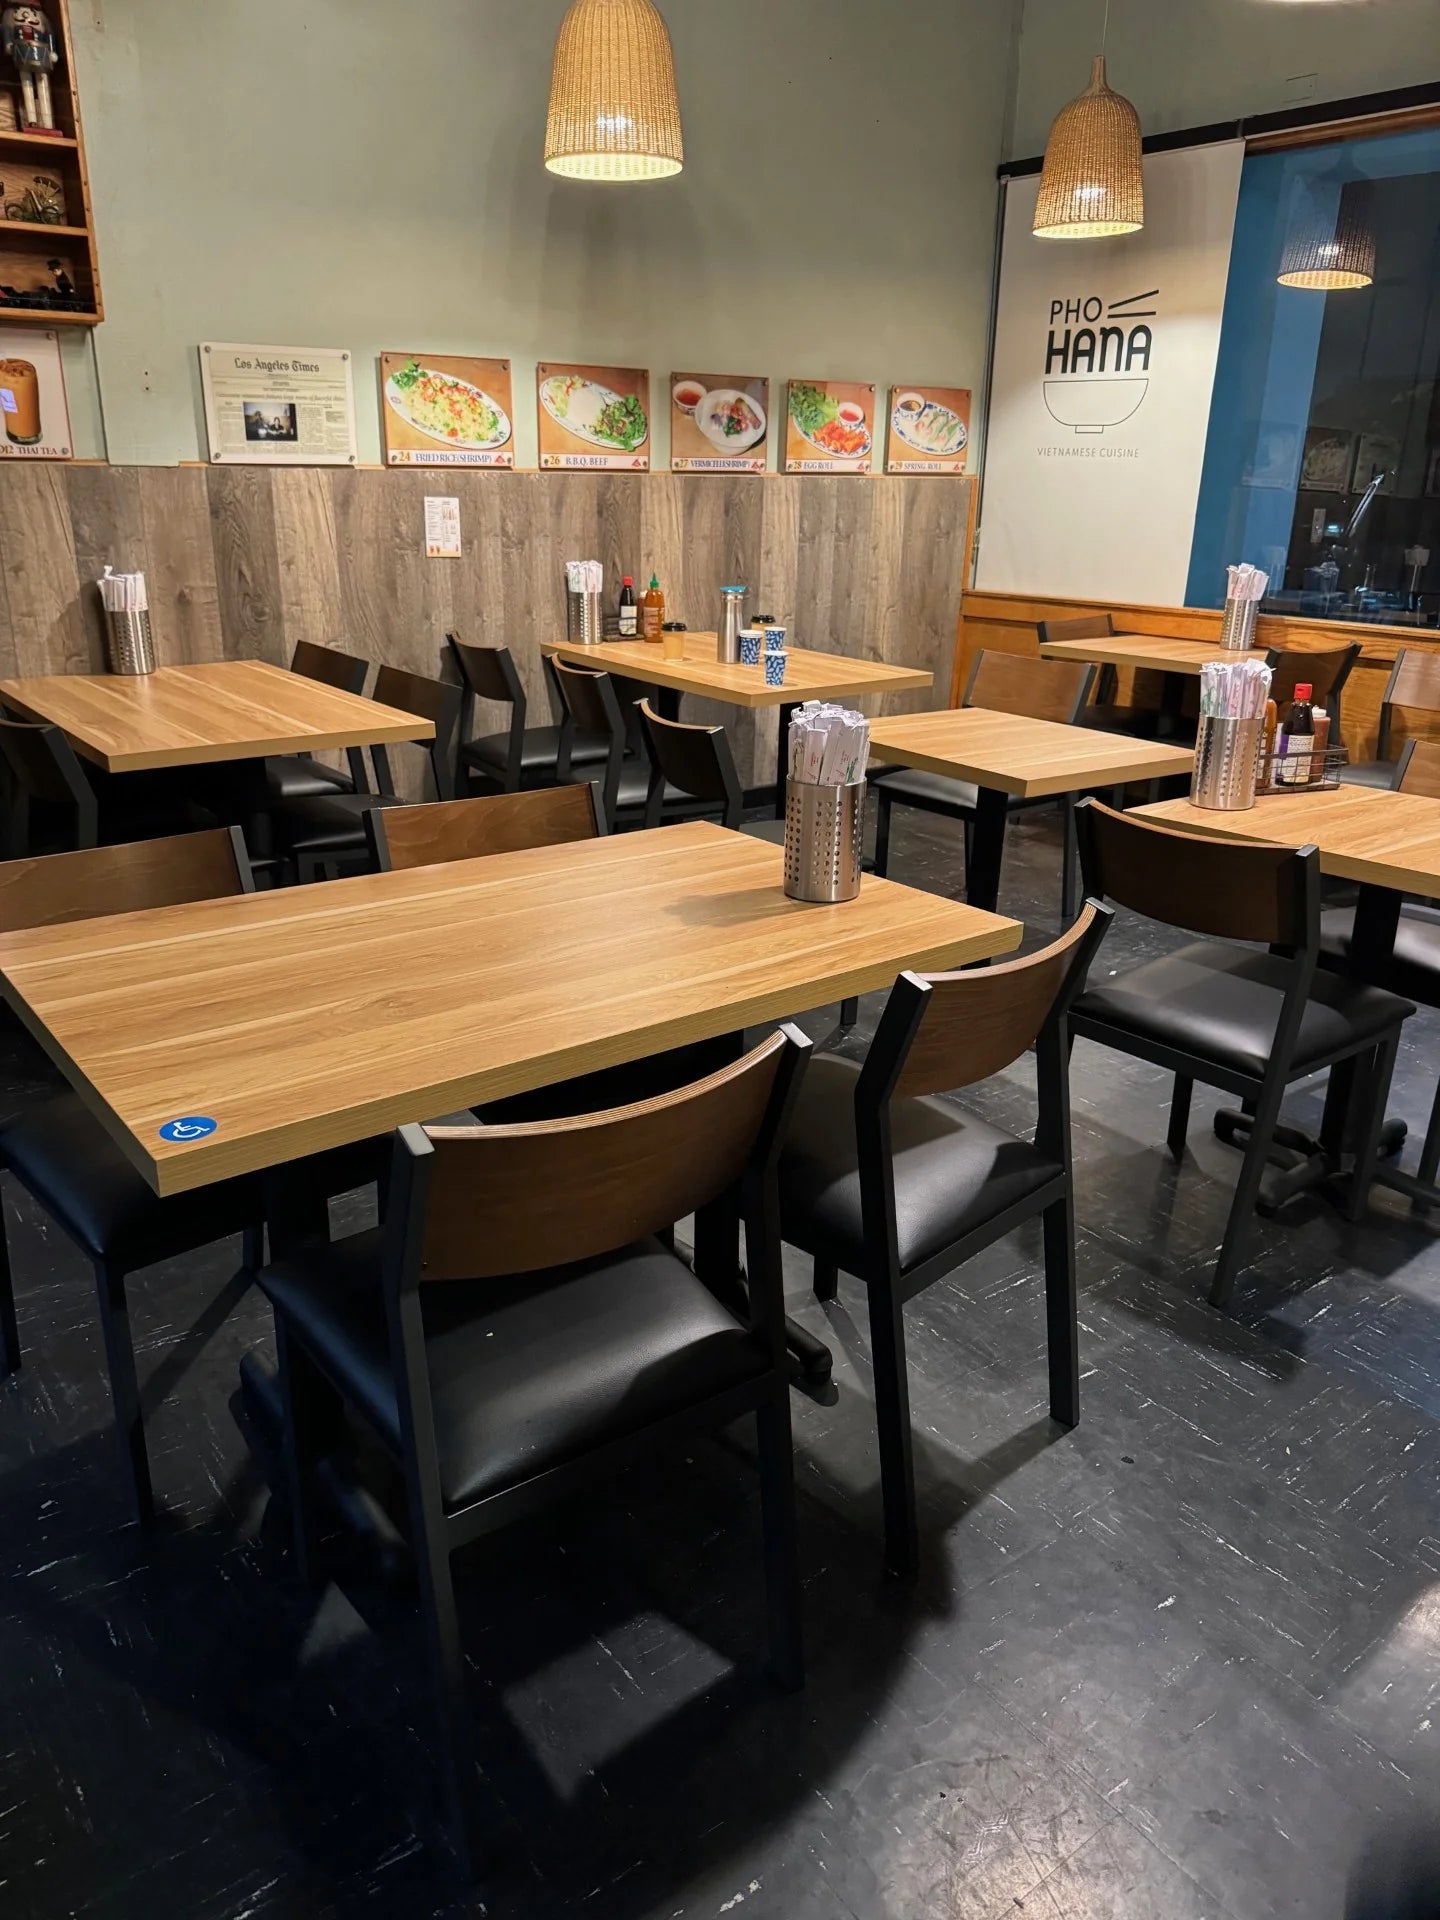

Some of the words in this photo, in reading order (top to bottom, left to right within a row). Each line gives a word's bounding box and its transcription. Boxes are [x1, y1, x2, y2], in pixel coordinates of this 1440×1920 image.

[1050, 296, 1102, 325] PHO
[1045, 325, 1152, 375] HANA
[234, 357, 252, 369] Los
[255, 359, 290, 372] Angeles
[292, 360, 320, 372] Times
[16, 446, 39, 454] THAI
[41, 447, 57, 455] TEA
[1037, 447, 1096, 457] VIETNAMESE
[1100, 448, 1139, 458] CUISINE
[399, 451, 410, 462] 24
[550, 455, 560, 465] 26
[589, 457, 608, 466] BEEF
[803, 462, 818, 470] EGG
[819, 462, 833, 470] ROLL
[904, 463, 926, 471] SPRING
[927, 463, 942, 471] ROLL
